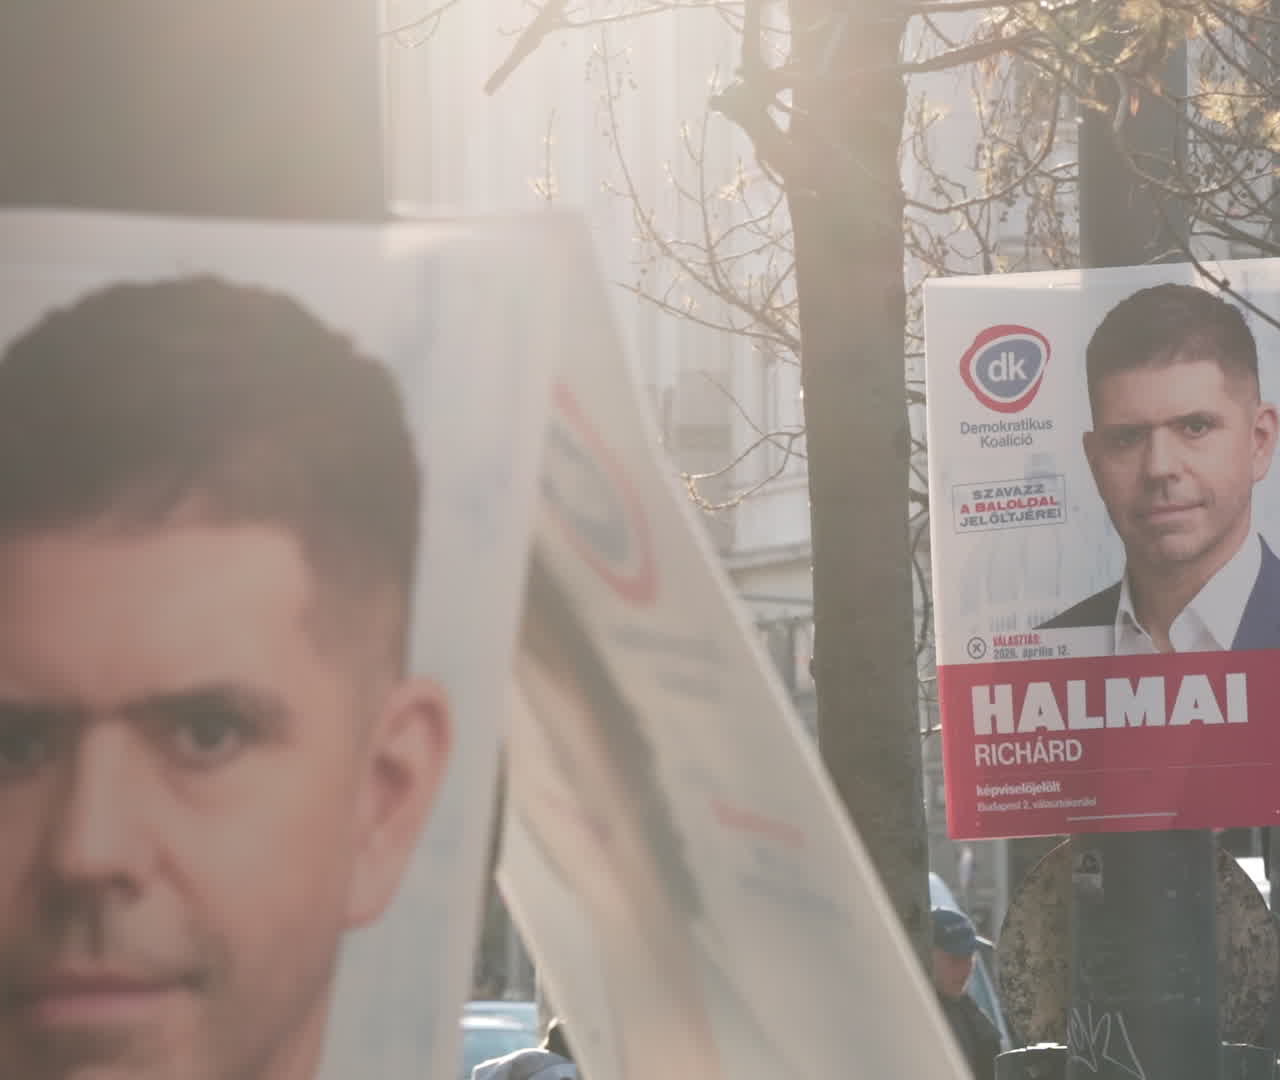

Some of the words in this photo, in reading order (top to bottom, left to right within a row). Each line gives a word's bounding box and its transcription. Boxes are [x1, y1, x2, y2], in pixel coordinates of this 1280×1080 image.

[988, 351, 1028, 381] dk
[960, 417, 1054, 435] Demokratikus
[980, 434, 1034, 449] Koalíció
[971, 483, 1046, 501] SZAVAZZ
[960, 503, 970, 515] A
[975, 496, 1059, 513] BALOLDAL
[959, 507, 1063, 528] JELÖLTJÉRE!
[970, 671, 1250, 736] HALMAI
[974, 737, 1084, 767] RICHÁRD
